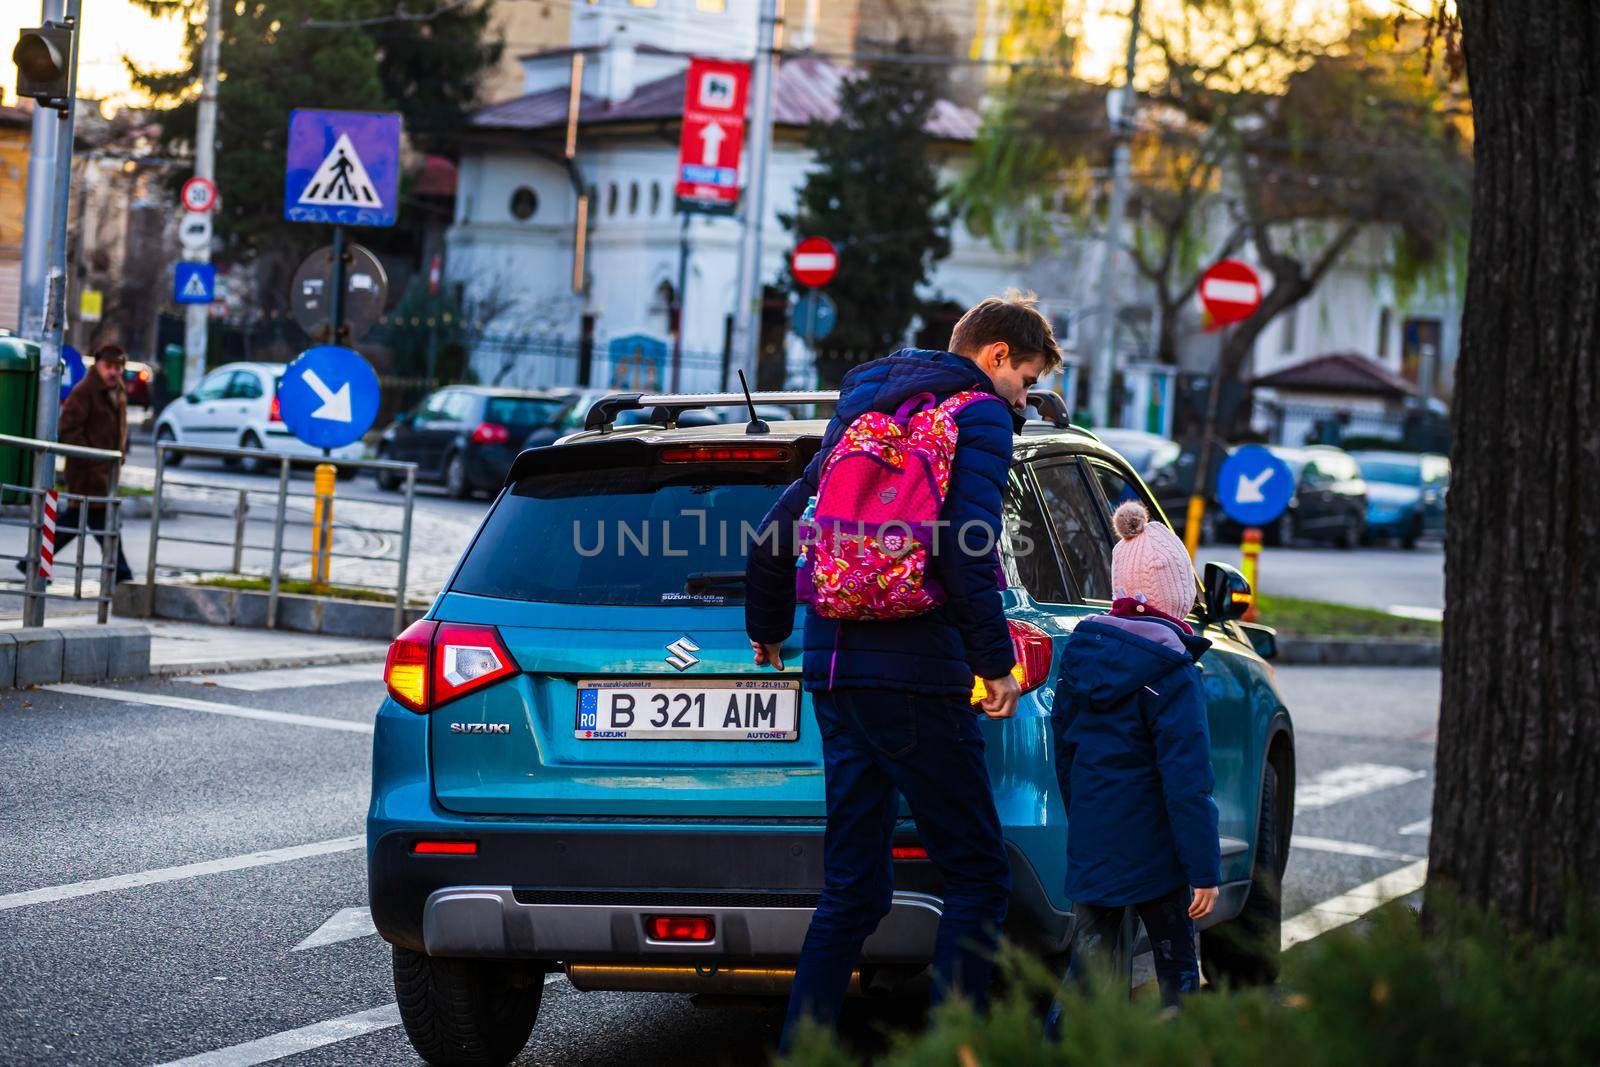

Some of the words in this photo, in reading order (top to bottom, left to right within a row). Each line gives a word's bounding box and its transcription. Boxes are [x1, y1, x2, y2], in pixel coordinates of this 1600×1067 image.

[611, 693, 636, 728] B
[650, 693, 706, 728] 321
[722, 693, 777, 728] AIM
[580, 713, 596, 727] RO
[450, 723, 510, 734] SUZUKI
